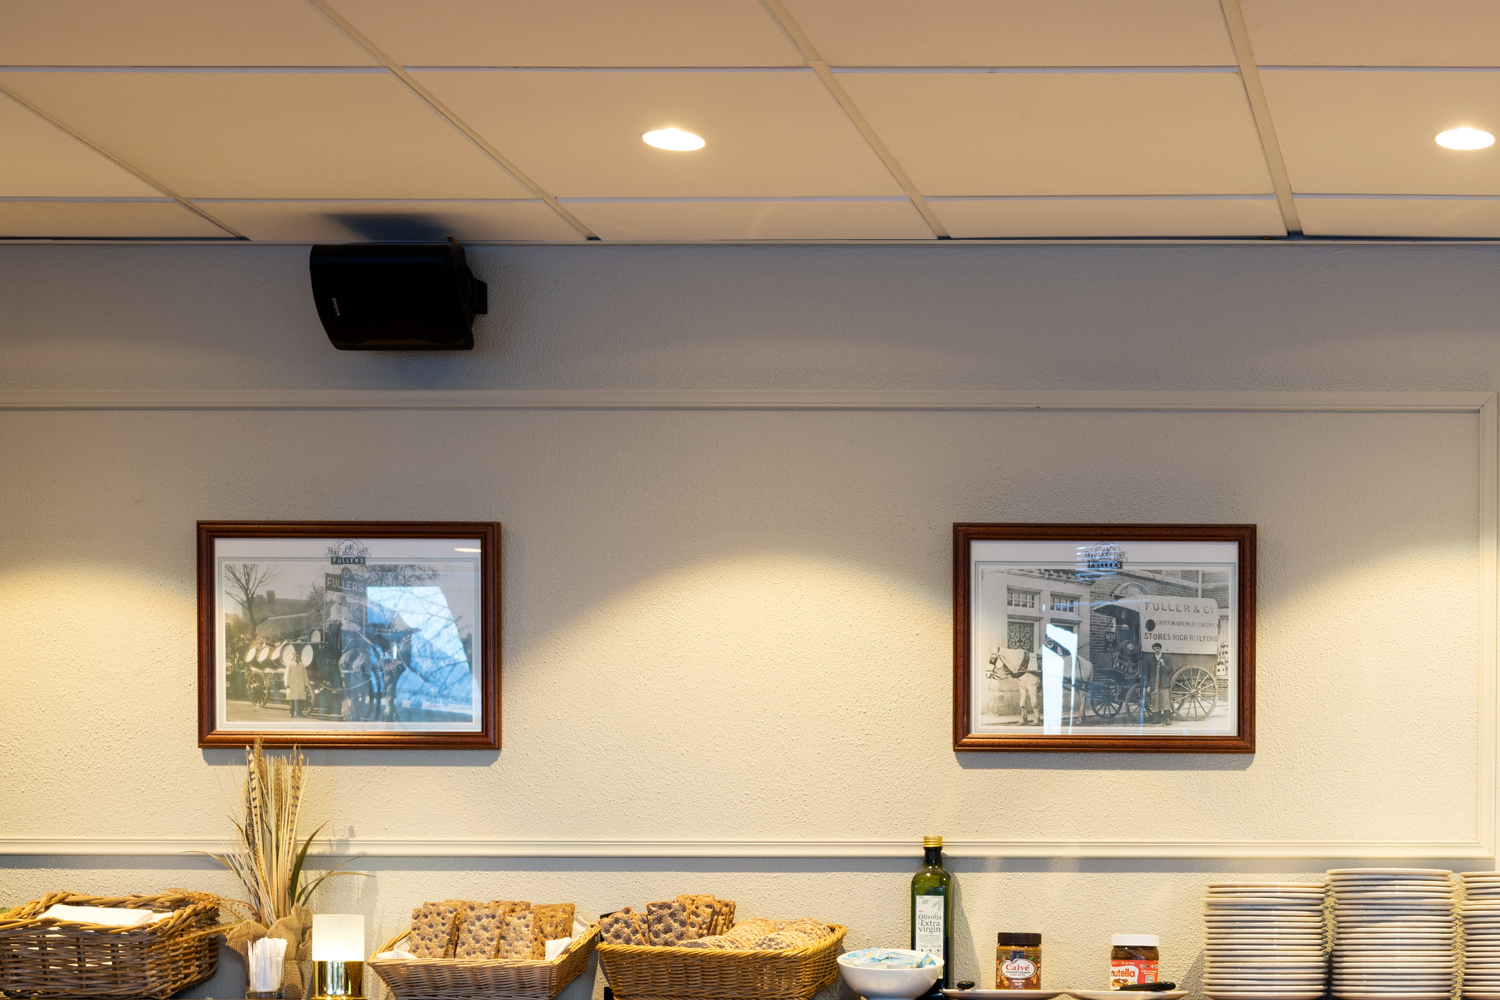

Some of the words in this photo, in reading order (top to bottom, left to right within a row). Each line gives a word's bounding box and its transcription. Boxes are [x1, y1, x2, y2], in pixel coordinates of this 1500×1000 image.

[1144, 602, 1191, 613] FULLER
[1193, 604, 1201, 614] &
[1144, 632, 1171, 641] STORES
[1172, 634, 1188, 642] HIGH
[918, 926, 941, 934] virgin
[1110, 968, 1136, 978] nutella
